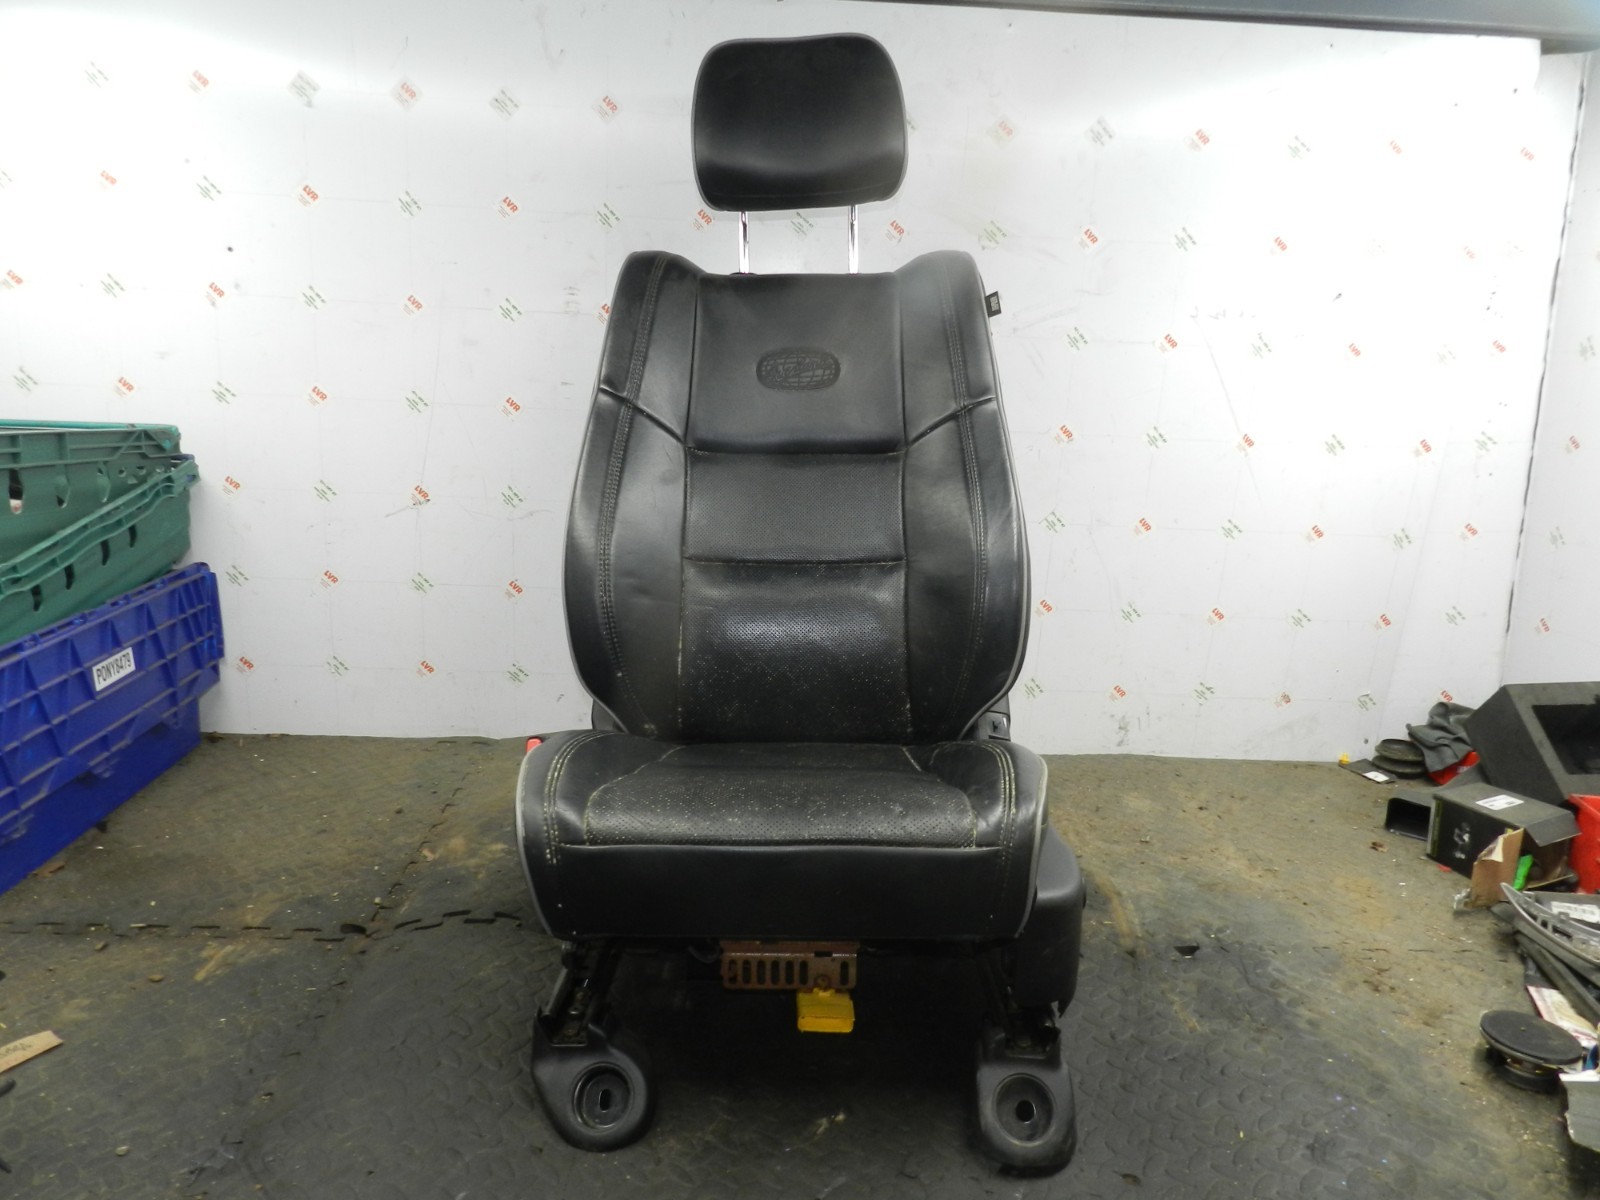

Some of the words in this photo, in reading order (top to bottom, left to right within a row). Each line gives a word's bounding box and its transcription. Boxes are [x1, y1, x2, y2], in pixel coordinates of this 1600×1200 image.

[401, 82, 416, 99] LVR
[603, 96, 617, 112] LVR
[304, 186, 318, 201] LVR
[503, 197, 518, 212] LVR
[697, 208, 711, 224] LVR
[890, 220, 905, 235] LVR
[1084, 228, 1098, 245] LVR
[209, 283, 224, 297] LVR
[407, 295, 422, 310] LVR
[1164, 335, 1177, 349] LVR
[119, 378, 133, 392] LVR
[312, 386, 327, 400] LVR
[506, 397, 520, 412] LVR
[1060, 425, 1072, 439] LVR
[1420, 439, 1432, 452] LVR
[225, 476, 240, 490] LVR
[416, 486, 429, 500] LVR
[1139, 518, 1151, 532] LVR
[1312, 526, 1324, 538] LVR
[324, 570, 337, 583] LVR
[509, 581, 522, 593] LVR
[1040, 599, 1053, 612] LVR
[1212, 607, 1224, 621] LVR
[1380, 614, 1391, 627] LVR
[96, 652, 132, 685] PONY8479
[240, 657, 253, 670] LVR
[420, 661, 434, 673] LVR
[1114, 685, 1126, 697] LVR
[1441, 690, 1453, 702] LVR
